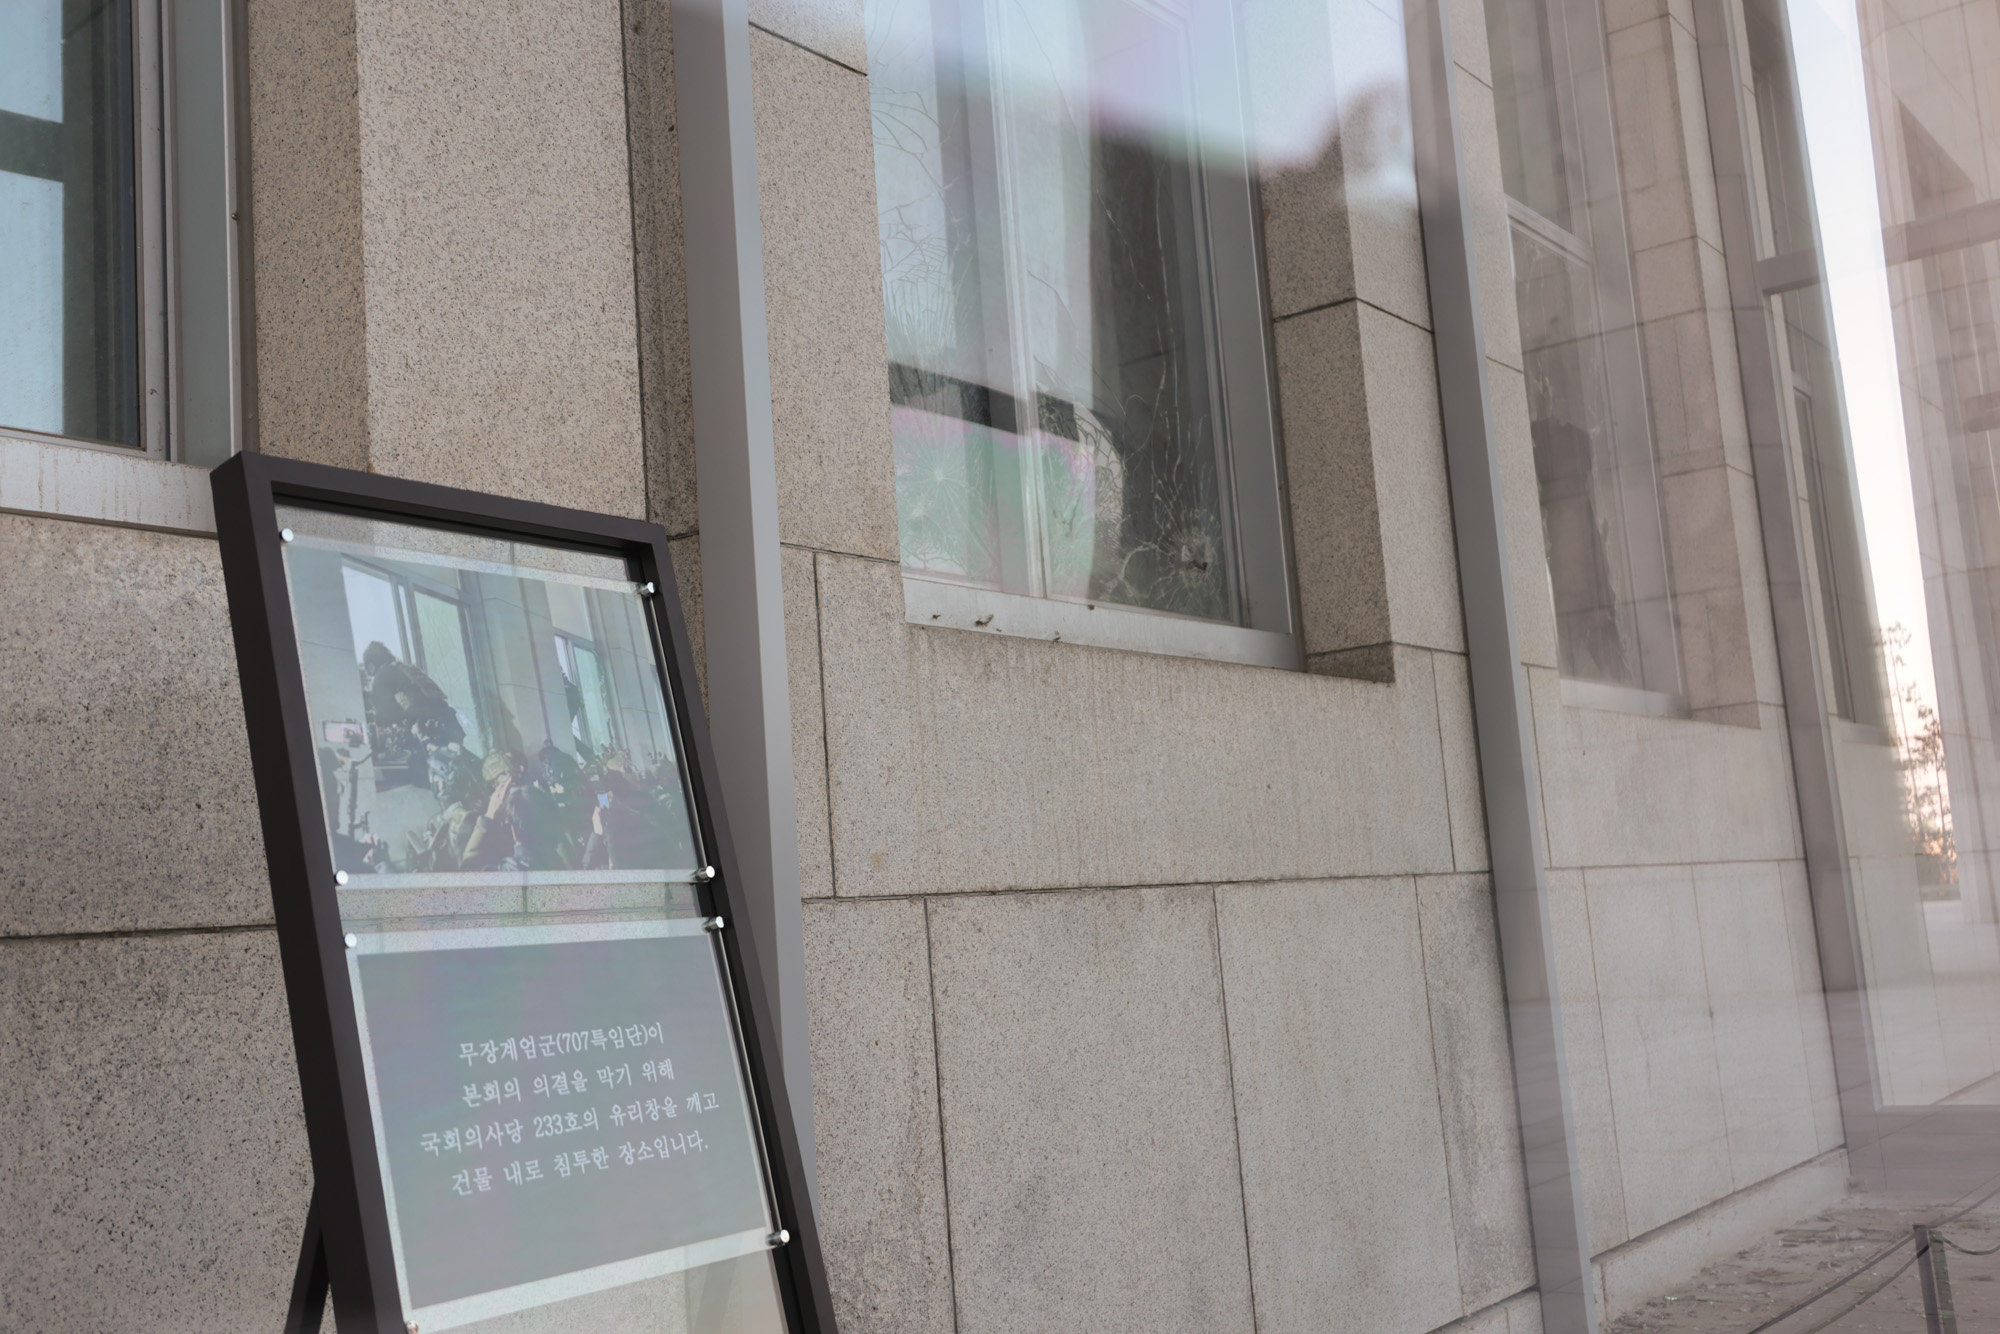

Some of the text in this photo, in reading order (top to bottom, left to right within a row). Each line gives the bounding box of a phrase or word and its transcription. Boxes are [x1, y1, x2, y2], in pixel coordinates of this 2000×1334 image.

[459, 1022, 664, 1067] 무장계엄군(707특임단)이
[462, 1058, 674, 1108] 본회의 의결을 막기 위해
[420, 1091, 720, 1157] 국회의사당 233호의 유리창을 깨고
[452, 1130, 709, 1196] 건물 내로 침투한 장소입니다.
